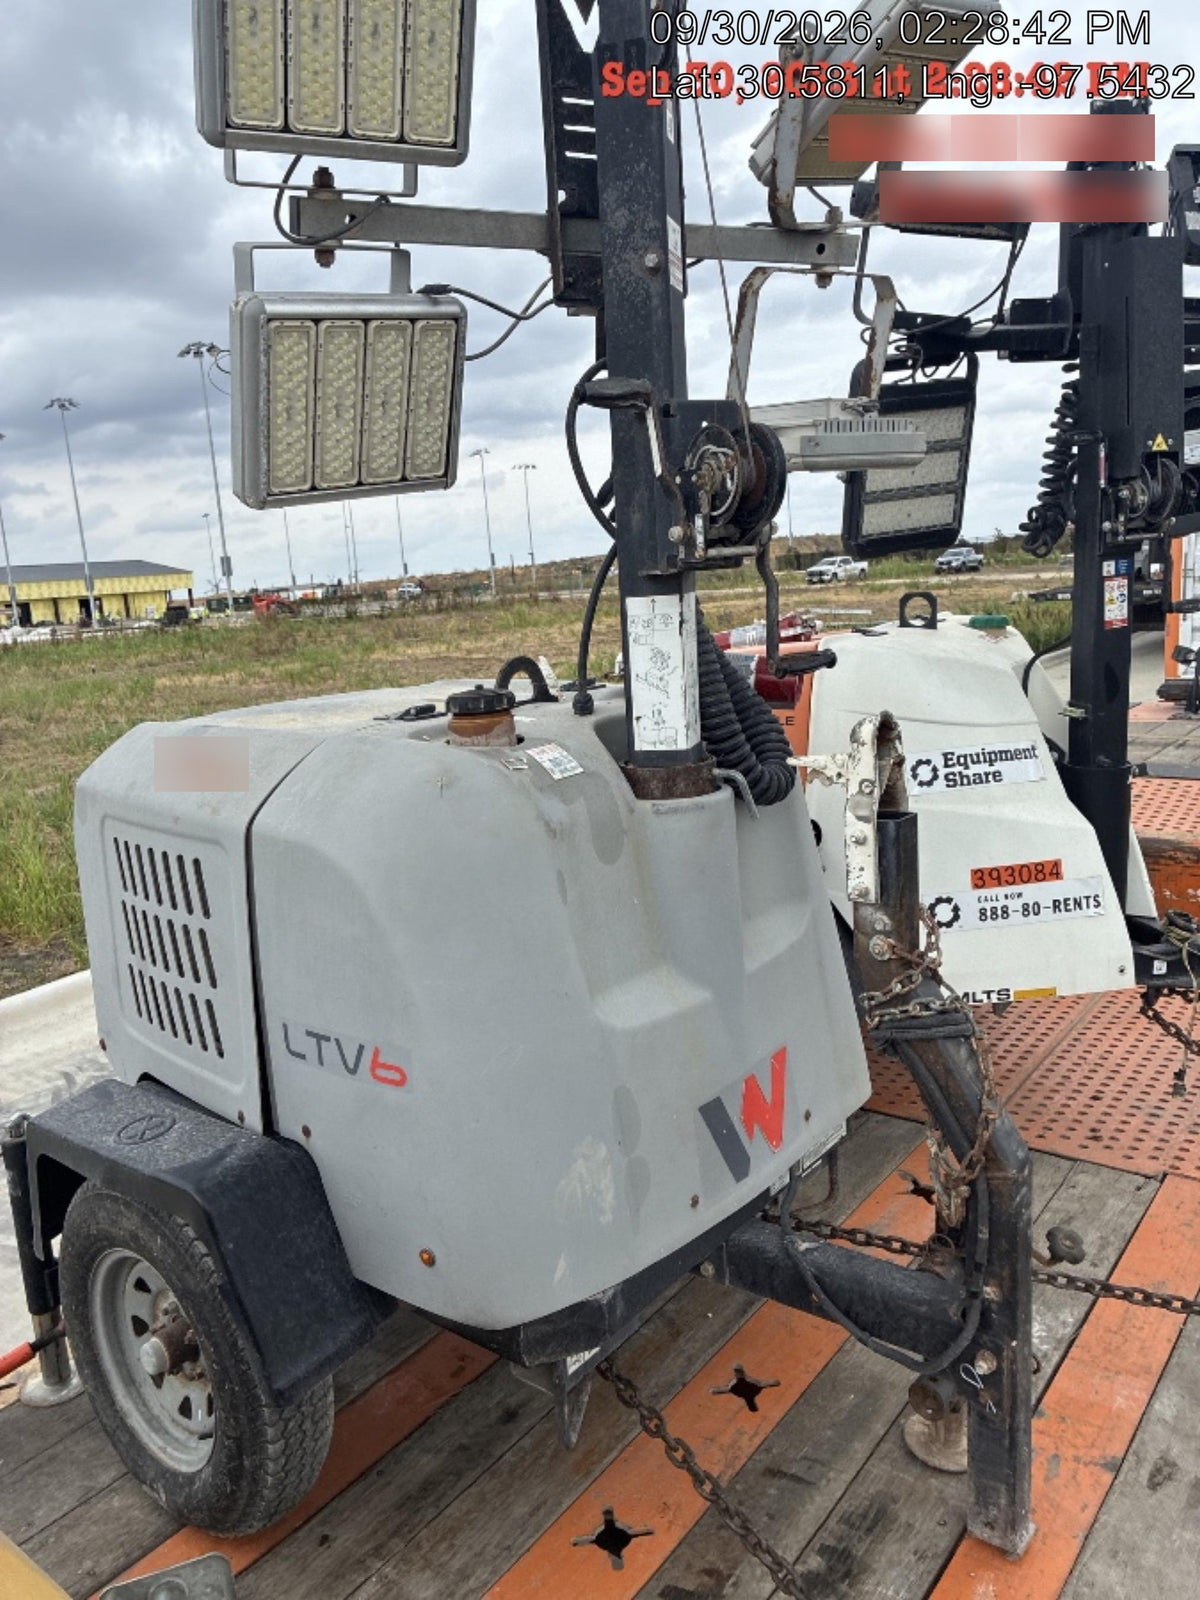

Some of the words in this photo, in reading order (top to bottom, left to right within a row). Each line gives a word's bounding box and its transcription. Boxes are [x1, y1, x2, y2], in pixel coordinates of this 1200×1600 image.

[941, 744, 1039, 770] Equipment
[943, 769, 1003, 788] Share
[973, 861, 1061, 889] 393084
[977, 894, 1001, 904] CALL
[1004, 891, 1023, 901] NOW
[978, 893, 1102, 922] 888-80-RENTS
